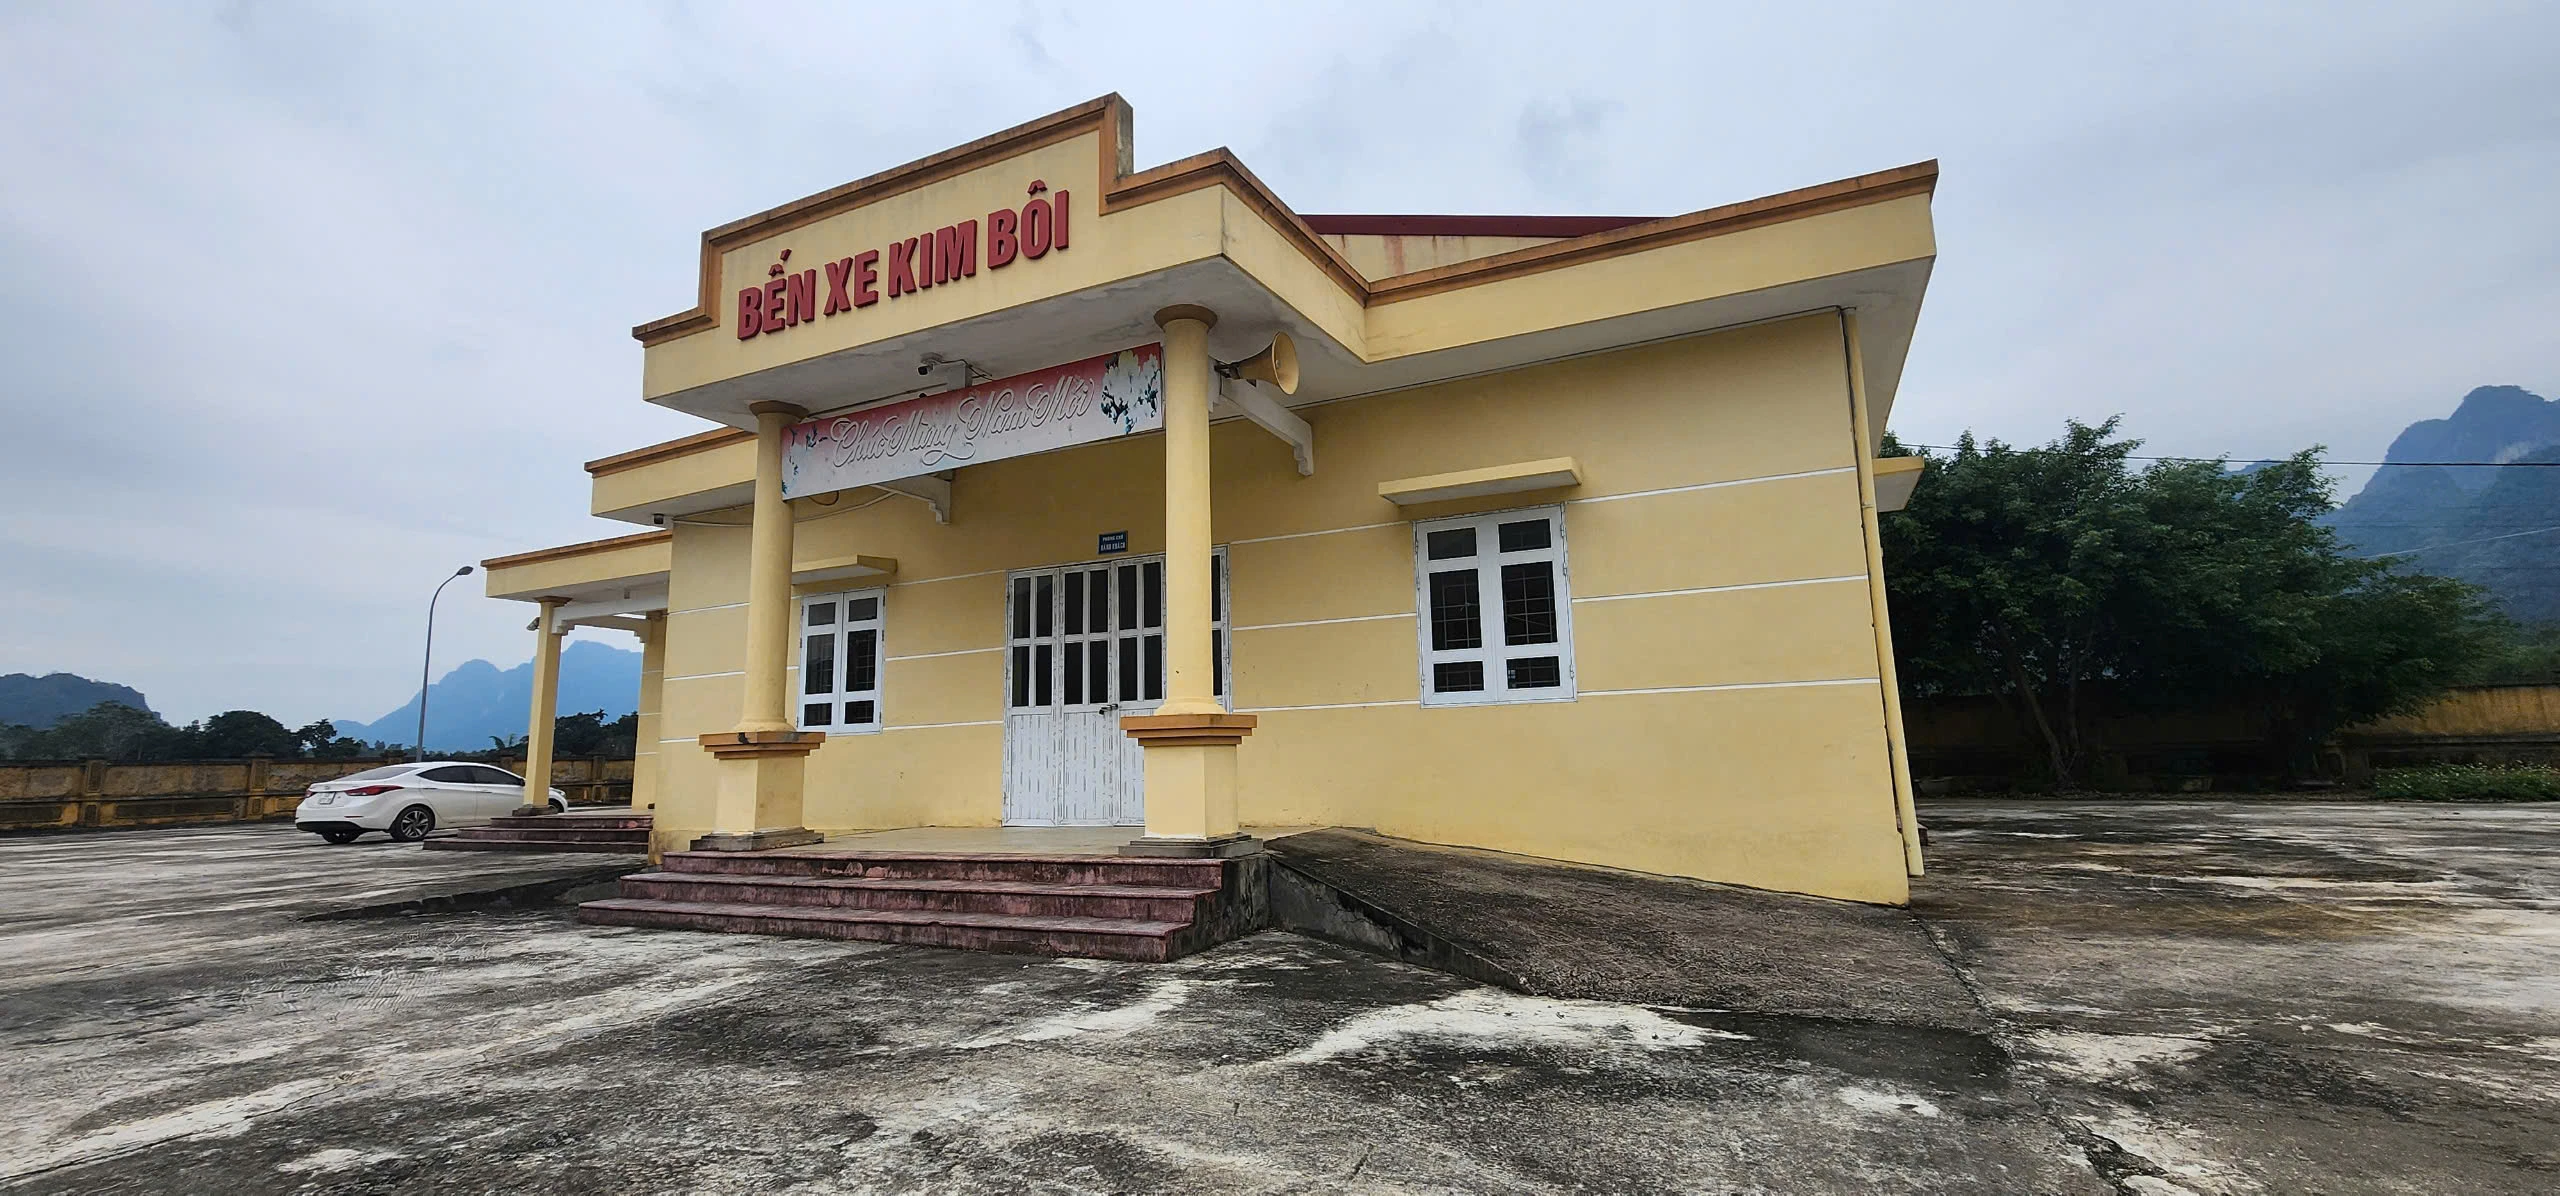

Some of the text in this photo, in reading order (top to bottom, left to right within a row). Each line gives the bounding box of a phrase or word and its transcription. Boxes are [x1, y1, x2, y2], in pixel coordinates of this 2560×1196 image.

[737, 179, 1070, 340] BẾN XE KIM BÔI
[830, 375, 1096, 468] Chúc Mừng Năm Mới
